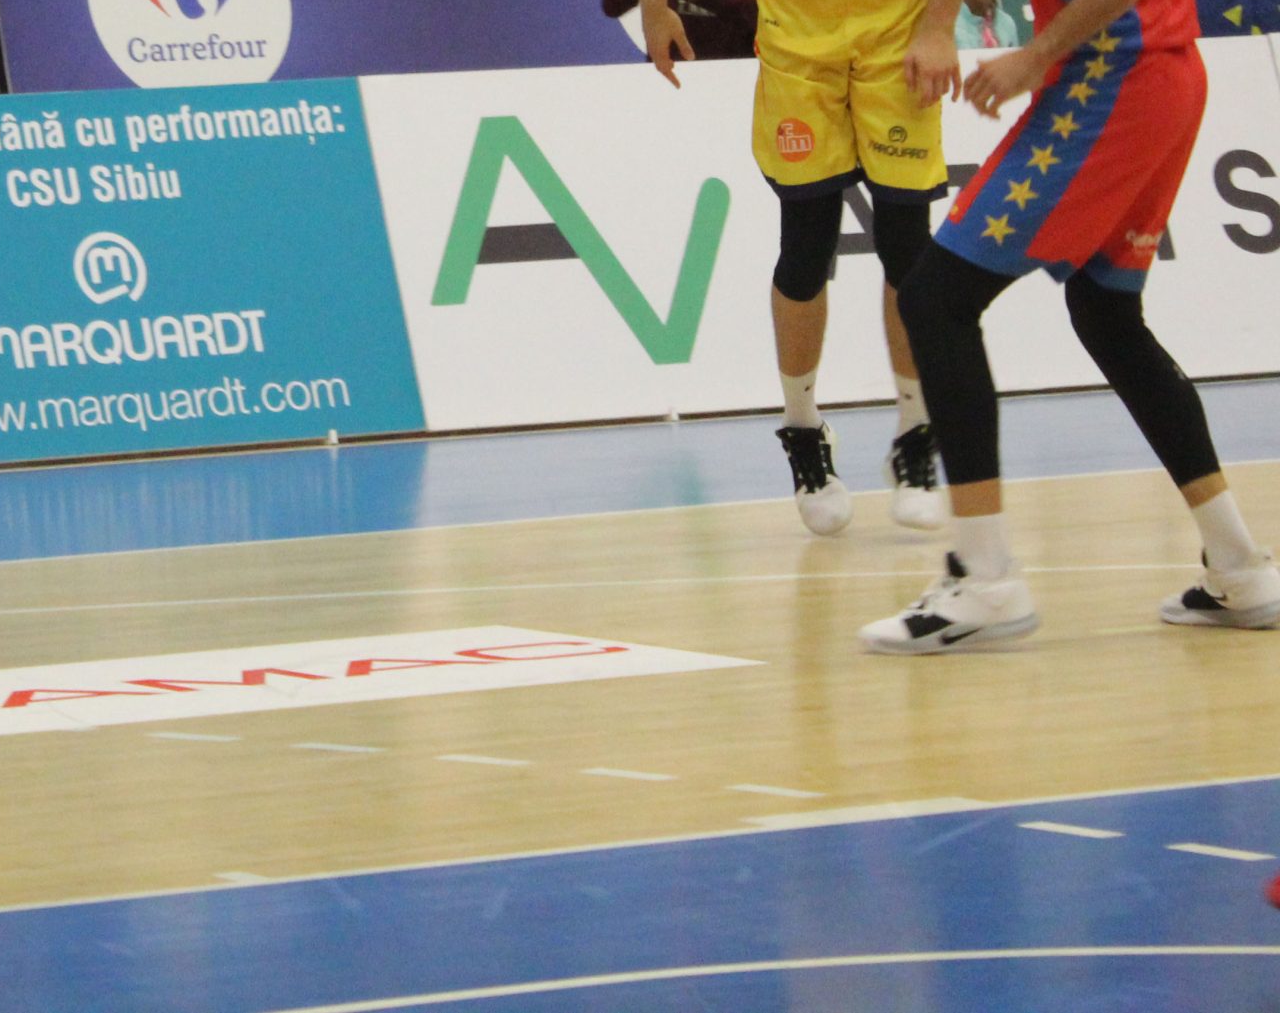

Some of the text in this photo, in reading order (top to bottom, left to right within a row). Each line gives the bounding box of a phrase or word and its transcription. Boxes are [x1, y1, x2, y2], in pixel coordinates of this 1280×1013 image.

[127, 33, 268, 63] Carrefour
[75, 115, 116, 147] cu
[7, 165, 182, 207] CSU Sibiu
